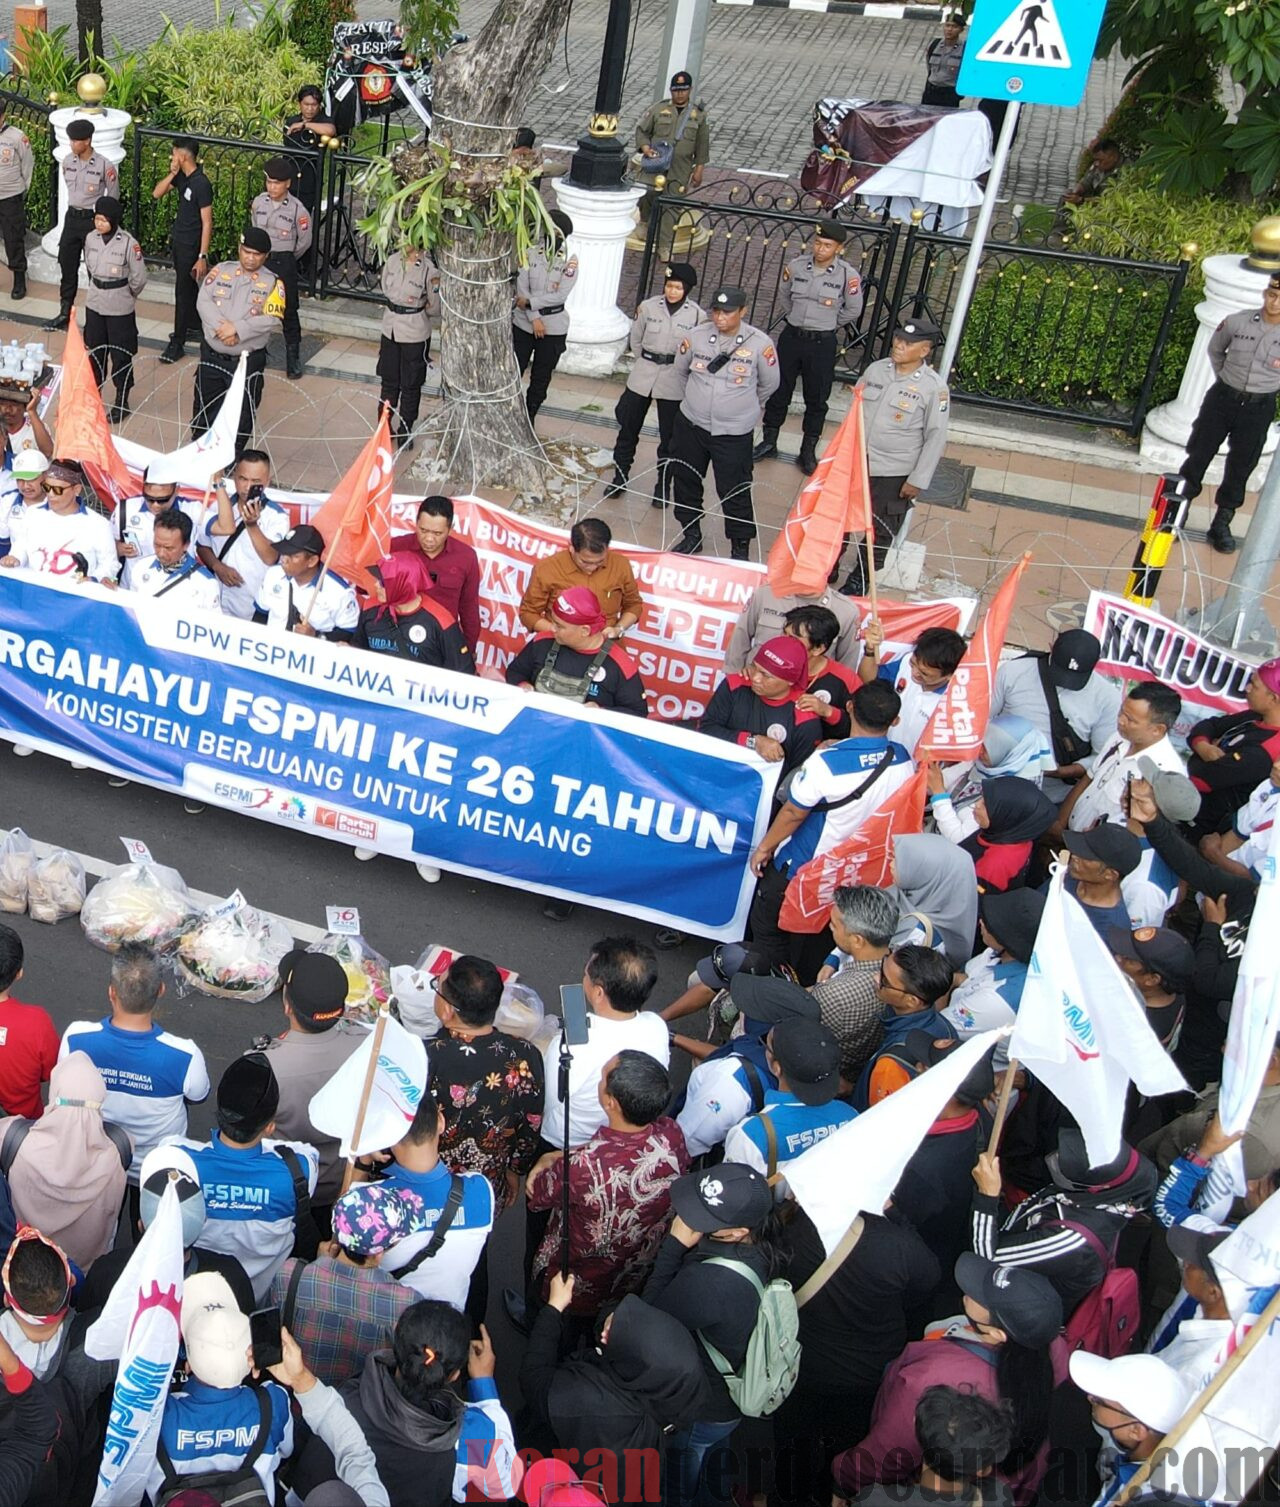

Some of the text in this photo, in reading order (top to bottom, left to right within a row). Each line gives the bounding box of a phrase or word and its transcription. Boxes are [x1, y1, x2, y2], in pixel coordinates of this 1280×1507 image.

[823, 282, 841, 290] POLRI
[732, 357, 753, 365] POLRI
[898, 391, 920, 401] POLRI
[475, 519, 558, 560] BURUH
[175, 618, 490, 718] DPW FSPMI JAWA TIMUR
[951, 668, 979, 744] Partai
[45, 687, 592, 858] KONSISTEN BERJUANG UNTUK MENANG
[222, 686, 375, 763] FSPMI
[388, 733, 460, 786] KE
[467, 754, 535, 806] 26
[552, 773, 738, 856] TAHUN
[214, 782, 253, 804] FSPMI
[338, 812, 374, 829] Partai
[338, 821, 374, 839] Buruh
[203, 1183, 270, 1205] FSPMI
